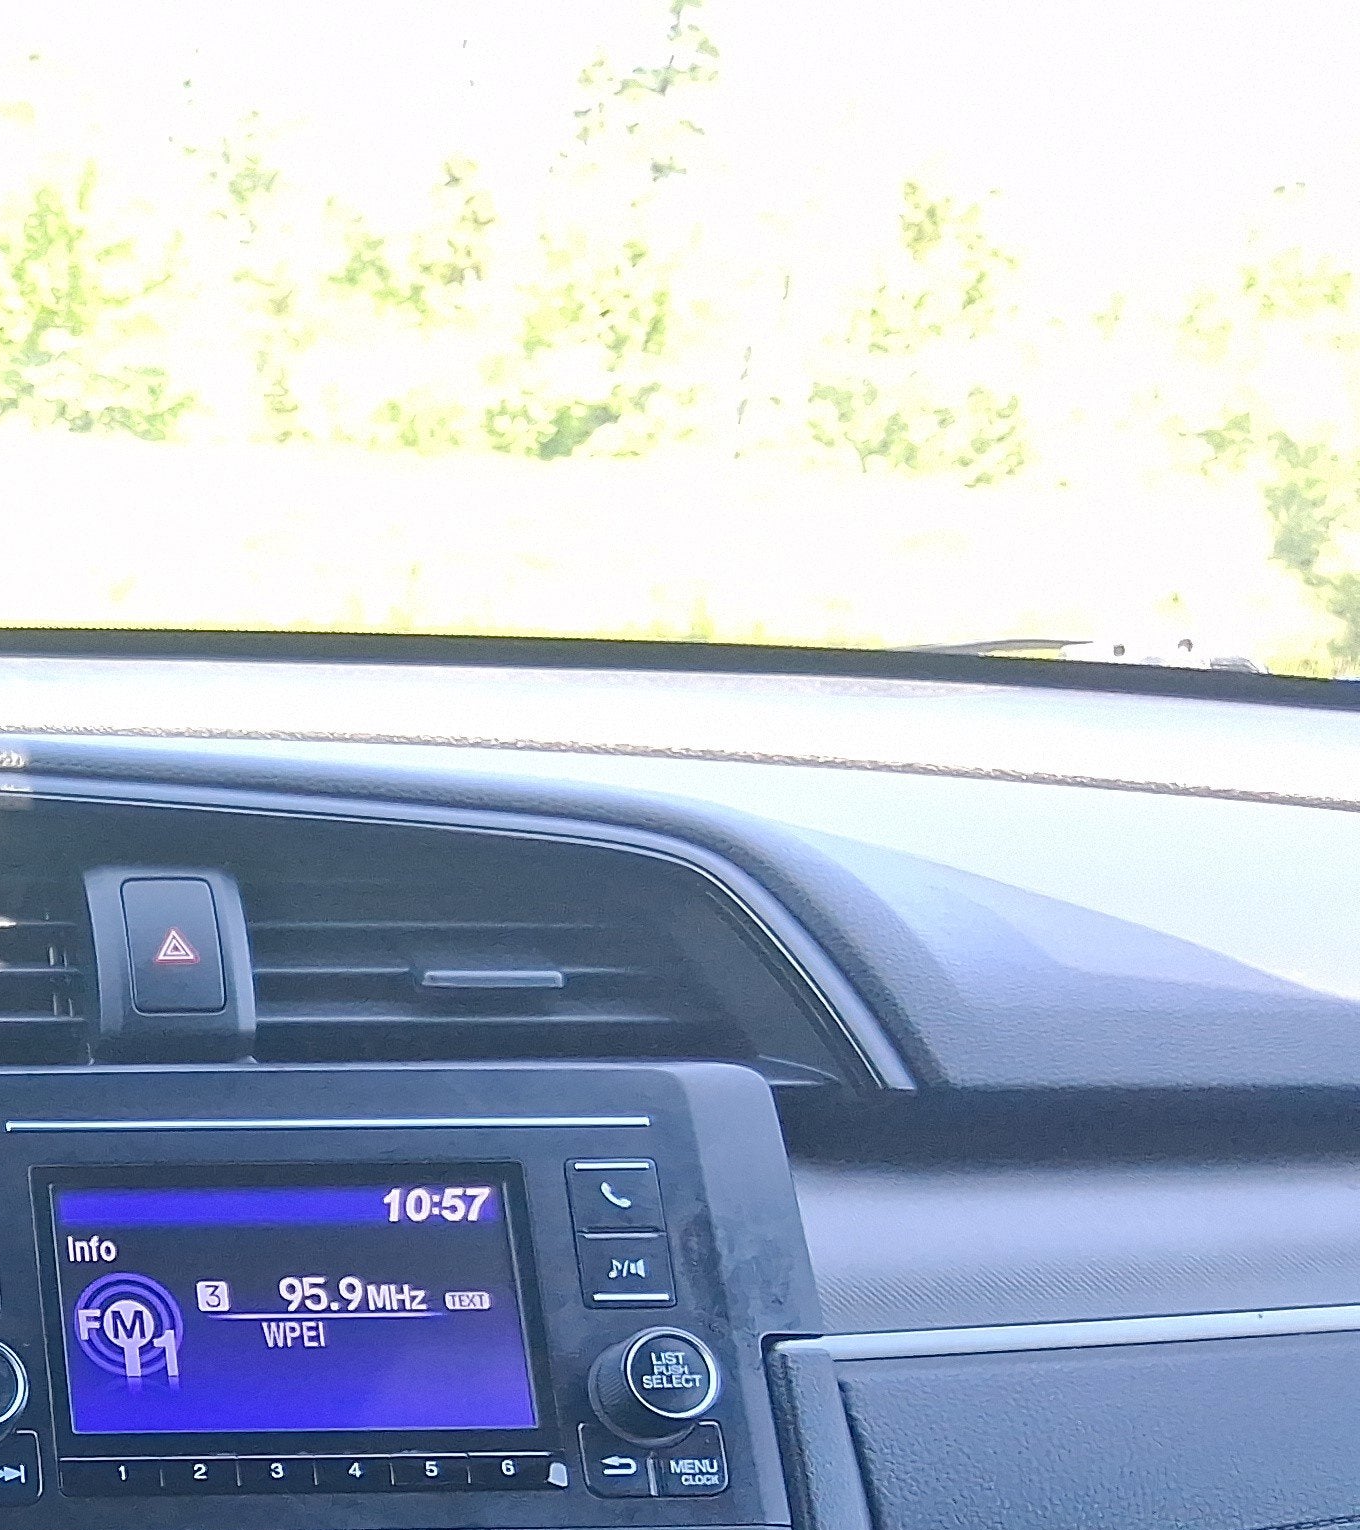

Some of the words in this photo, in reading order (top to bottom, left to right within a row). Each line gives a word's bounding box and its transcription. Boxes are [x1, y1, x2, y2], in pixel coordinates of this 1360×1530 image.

[382, 1185, 491, 1223] 10:57
[67, 1234, 117, 1263] Info
[278, 1276, 363, 1312] 95.9
[367, 1284, 428, 1311] MHz
[450, 1293, 488, 1308] TEXT
[261, 1320, 326, 1349] WPEI
[650, 1352, 685, 1365] LIST
[653, 1364, 689, 1375] PUSH
[642, 1375, 703, 1389] SELECT
[118, 1465, 128, 1481] 1
[193, 1463, 208, 1480] 2
[270, 1462, 284, 1479] 3
[348, 1461, 362, 1477] 4
[425, 1461, 438, 1477] 5
[501, 1460, 515, 1476] 6
[669, 1459, 718, 1474] MENU
[681, 1474, 720, 1486] CLOCK
